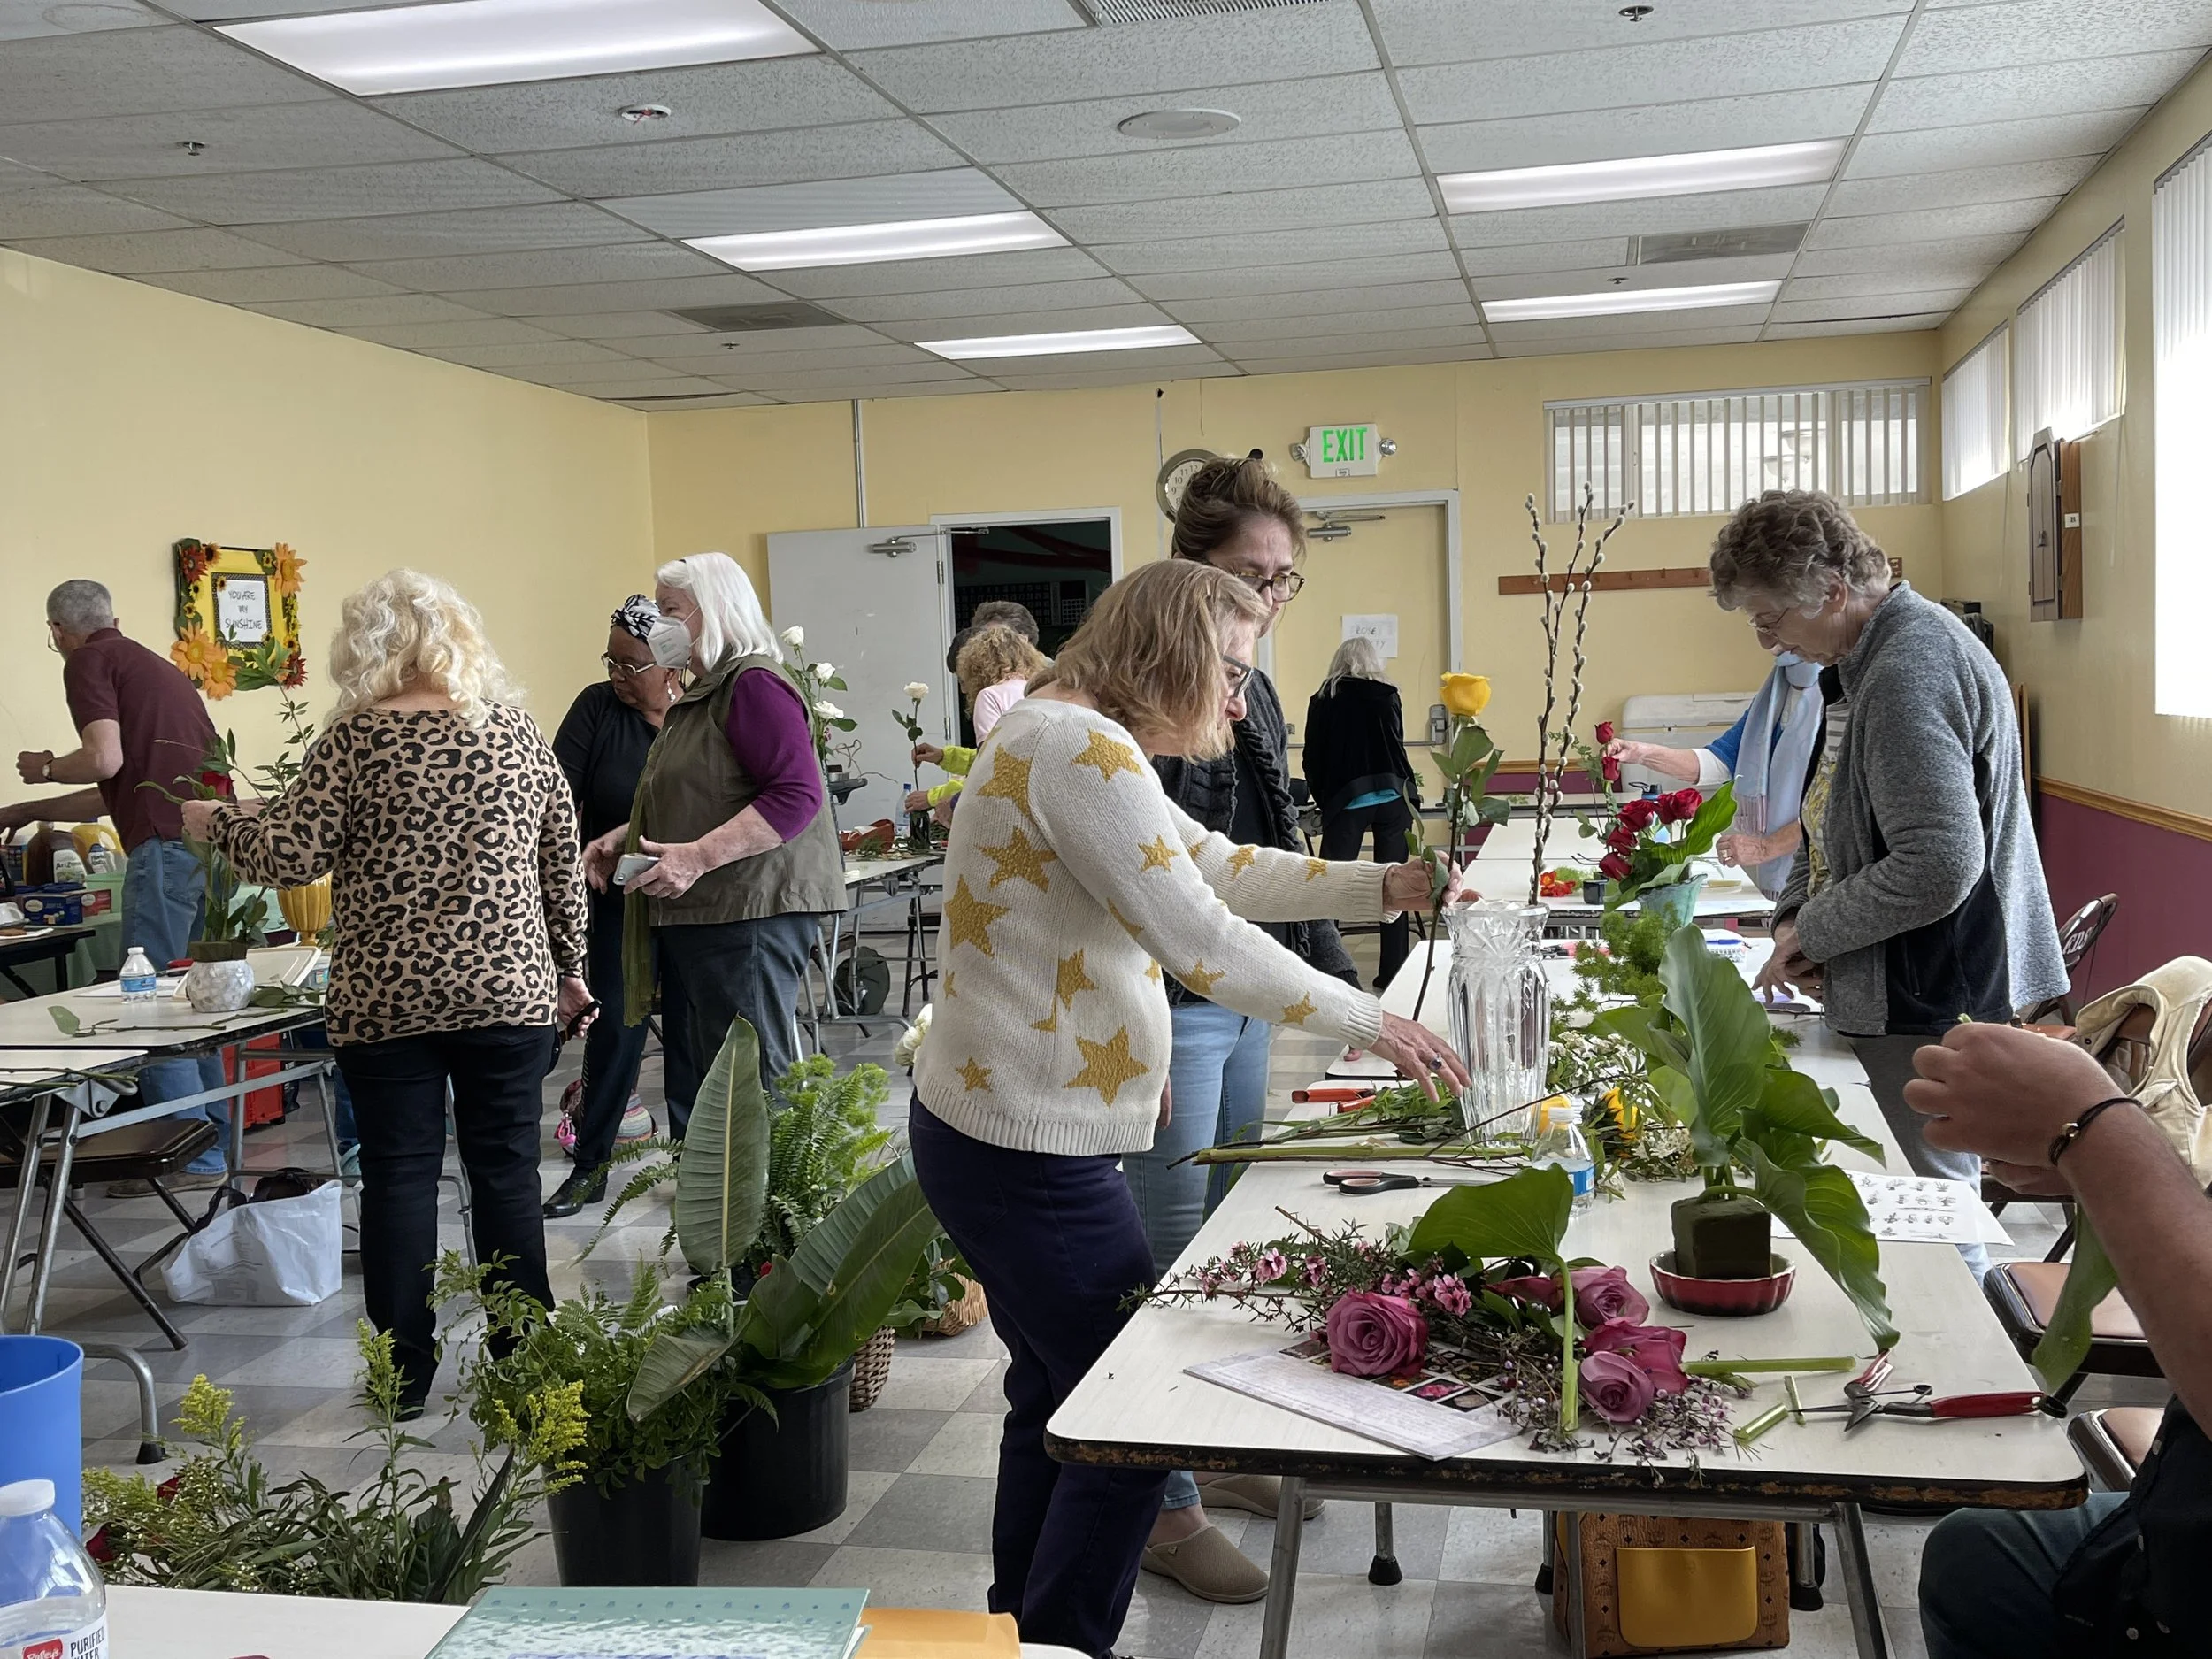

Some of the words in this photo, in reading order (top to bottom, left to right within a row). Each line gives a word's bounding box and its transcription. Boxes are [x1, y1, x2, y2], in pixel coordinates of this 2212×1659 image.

[1322, 427, 1368, 463] EXIT
[1171, 487, 1177, 495] 9
[228, 590, 242, 600] YOU
[242, 590, 256, 601] ARE
[237, 605, 249, 614] MY
[70, 1626, 105, 1657] PURIFIED
[73, 1647, 100, 1659] ATER
